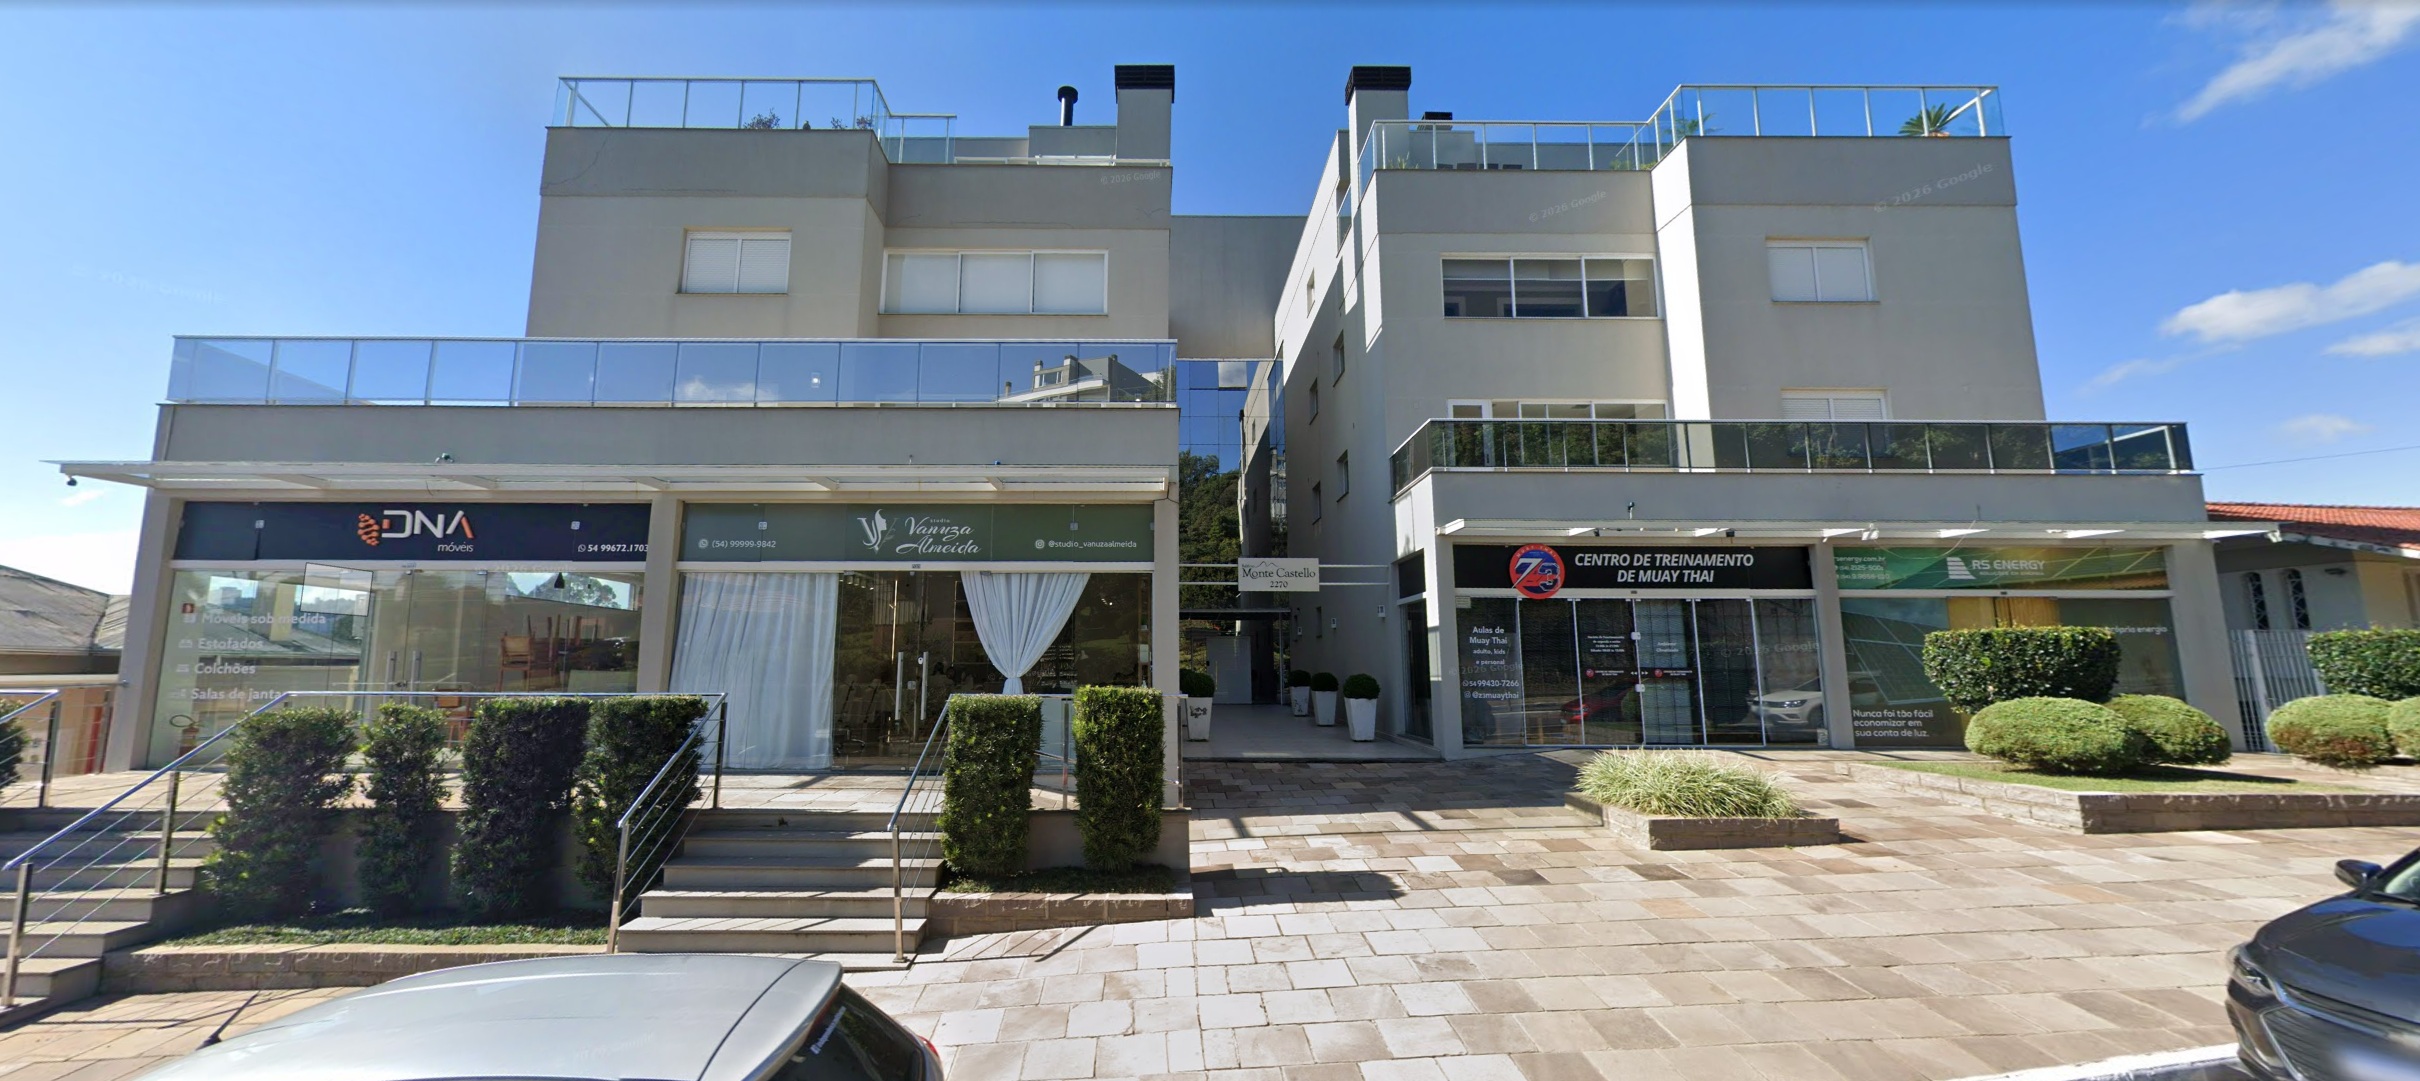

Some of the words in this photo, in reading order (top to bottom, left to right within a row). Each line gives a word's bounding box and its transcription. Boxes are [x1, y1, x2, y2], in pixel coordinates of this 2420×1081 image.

[381, 509, 475, 539] DNA
[904, 516, 974, 542] Vanuza
[437, 541, 474, 553] móveis
[587, 544, 599, 552] 54
[712, 540, 729, 549] (54)
[730, 540, 777, 548] 99999-9842
[895, 534, 982, 555] Almeida
[1048, 540, 1137, 549] @studio_vanuzaalmeida
[1574, 553, 1631, 567] CENTRO
[1633, 553, 1651, 567] DE
[1654, 553, 1755, 567] TREINAMENTO
[1972, 559, 1991, 570] RS
[1993, 559, 2046, 570] ENERGY
[1242, 567, 1274, 580] Monte
[1276, 567, 1316, 578] Castello
[1617, 569, 1636, 583] DE
[1638, 569, 1680, 583] MUAY
[1683, 569, 1715, 583] THAI
[1270, 580, 1289, 588] 2270
[201, 612, 249, 625] Móveis
[250, 613, 275, 625] sob
[278, 613, 327, 625] medida
[1472, 626, 1493, 634] Aulas
[1494, 626, 1505, 634] de
[198, 637, 264, 650] Estofados
[1469, 637, 1491, 646] Muay
[1492, 637, 1508, 645] Thai
[194, 662, 256, 675] Colchões
[191, 687, 225, 700] Salas
[228, 687, 242, 700] de
[1853, 710, 1882, 718] Nunca
[1883, 709, 1895, 718] foi
[1897, 709, 1913, 718] tão
[1913, 709, 1934, 718] fácil
[1853, 719, 1906, 727] economizar
[1900, 729, 1912, 737] de
[1914, 729, 1930, 737] luz.
